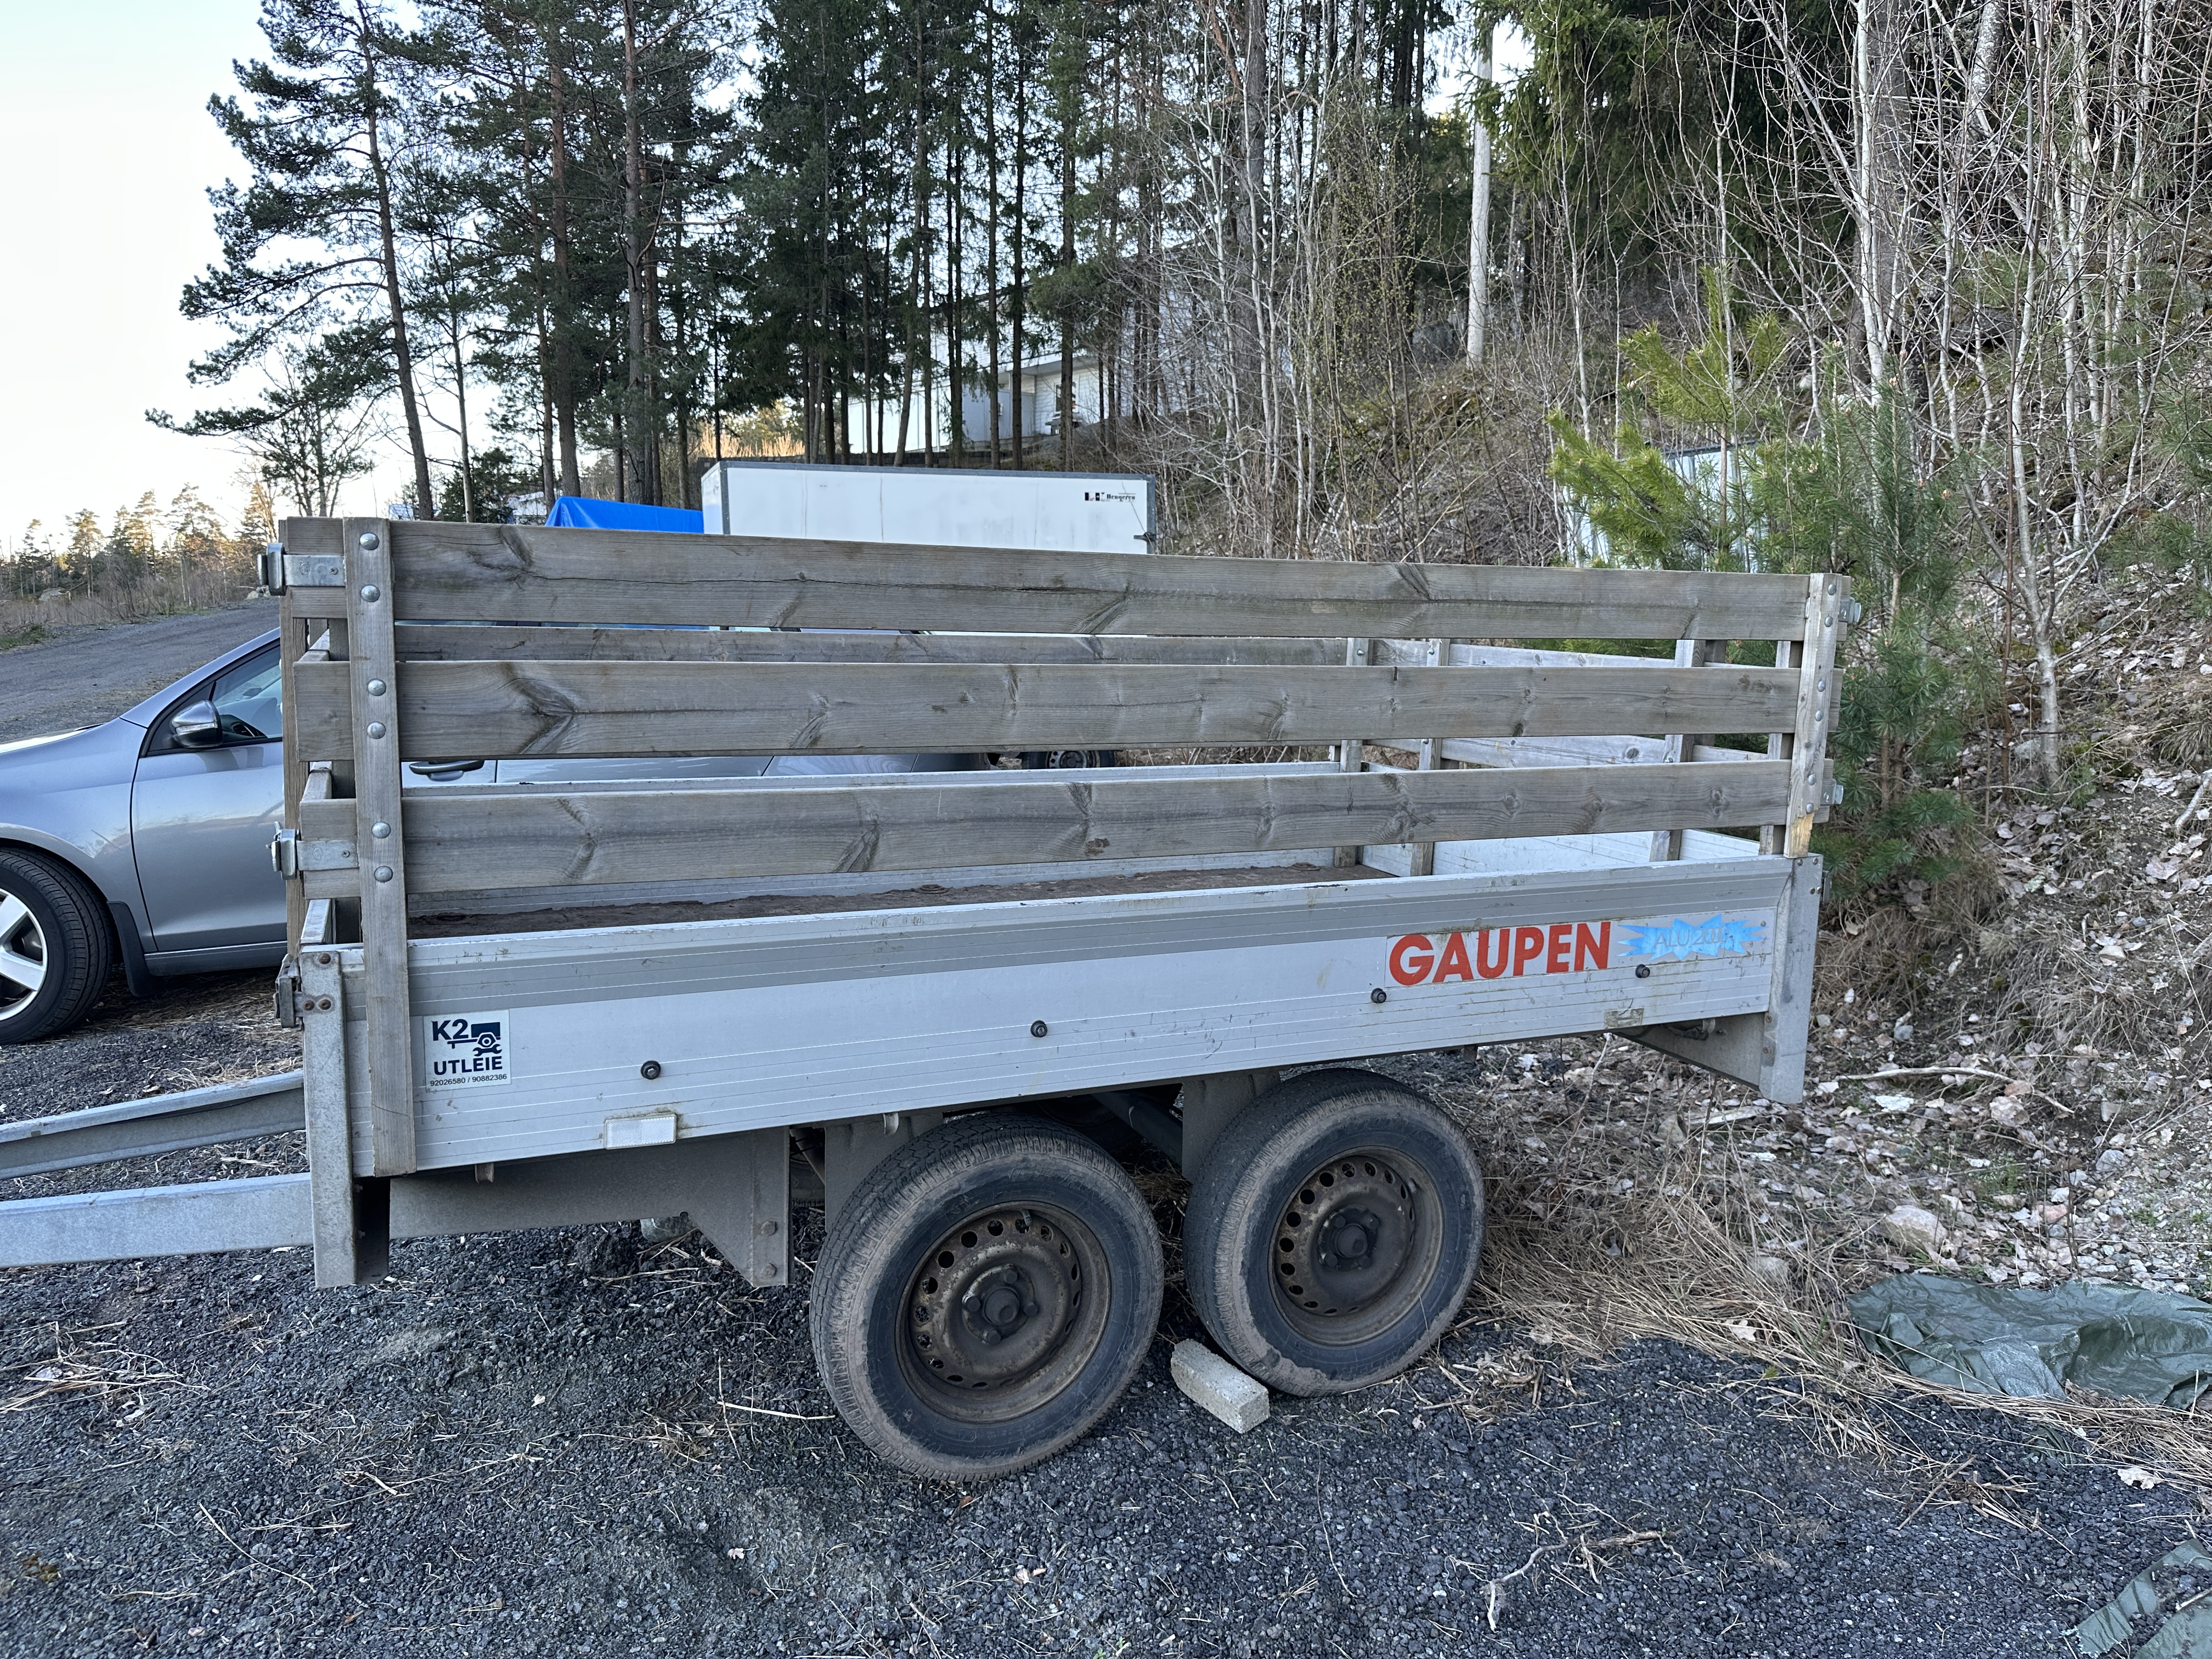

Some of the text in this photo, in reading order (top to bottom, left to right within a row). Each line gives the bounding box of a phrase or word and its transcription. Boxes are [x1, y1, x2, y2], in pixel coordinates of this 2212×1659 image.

[1654, 930, 1690, 949] ALU
[1389, 921, 1611, 985] GAUPEN
[431, 1019, 469, 1041] K2
[434, 1056, 503, 1075] UTLEIE
[430, 1078, 466, 1086] 92026580
[472, 1074, 507, 1082] 90882386
